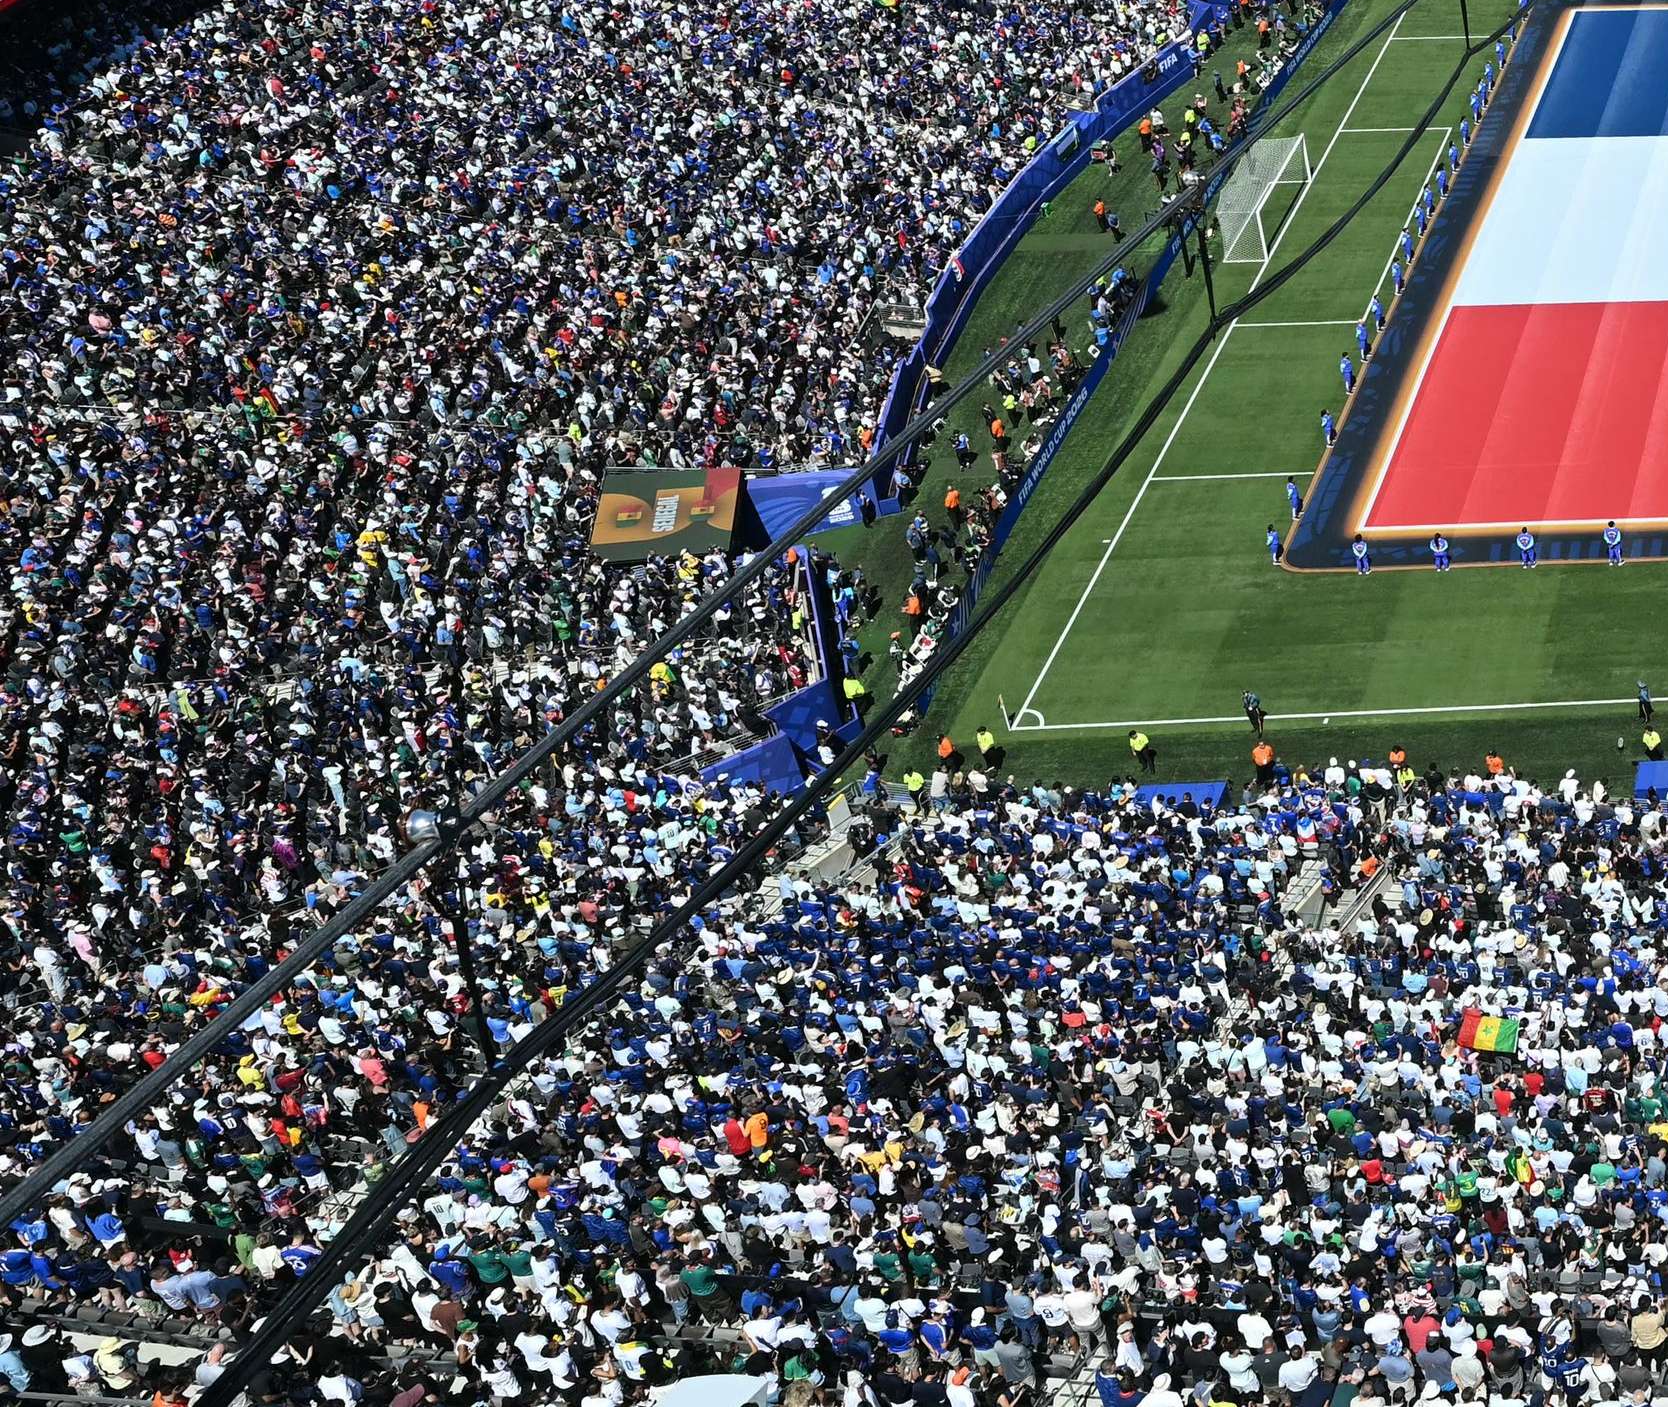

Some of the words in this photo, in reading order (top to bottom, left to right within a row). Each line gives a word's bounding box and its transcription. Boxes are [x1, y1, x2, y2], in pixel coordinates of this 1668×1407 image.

[1159, 53, 1178, 72] FIFA
[1017, 480, 1034, 505] FIFA
[1031, 446, 1055, 479] WORLD
[1053, 427, 1066, 449] CUP
[1065, 389, 1088, 425] 2026
[1564, 1374, 1579, 1387] 10
